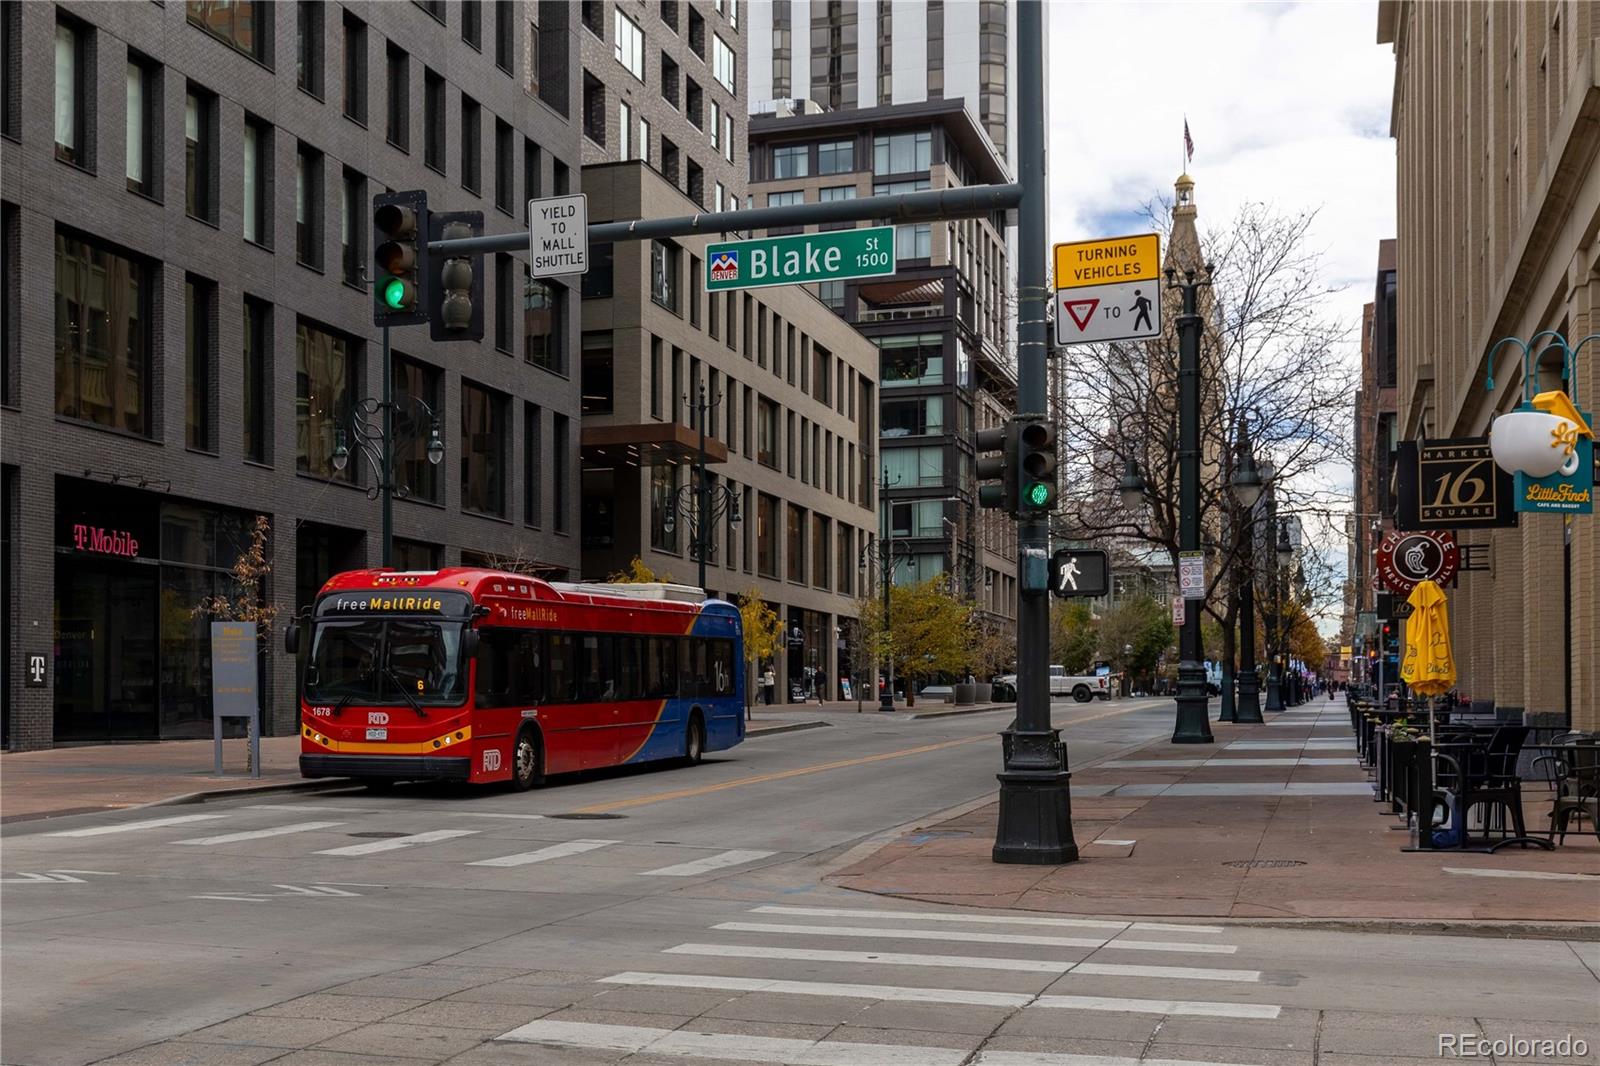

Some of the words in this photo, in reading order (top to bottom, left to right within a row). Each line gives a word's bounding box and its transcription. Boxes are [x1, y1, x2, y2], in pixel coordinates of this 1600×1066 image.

[541, 205, 575, 219] YIELD
[551, 222, 566, 234] TO
[543, 237, 575, 252] MALL
[866, 237, 879, 250] St
[535, 252, 584, 268] SHUTTLE
[856, 252, 888, 267] 1500
[1077, 244, 1137, 261] TURNING
[751, 242, 842, 279] Blake
[712, 270, 738, 281] DENVER
[1074, 262, 1142, 280] VEHICLES
[1103, 306, 1121, 319] TO
[1423, 449, 1491, 459] MARKET
[1434, 459, 1486, 507] 16
[1526, 483, 1561, 501] Little
[1558, 483, 1591, 502] Finch
[1423, 507, 1491, 518] SQUARE
[89, 527, 139, 557] Mobile
[1382, 529, 1455, 553] CHILE
[1383, 566, 1416, 591] MEXIC
[1435, 564, 1454, 585] RILL
[417, 680, 424, 690] 6
[312, 707, 331, 717] 1678
[368, 712, 389, 725] RTD
[483, 749, 502, 772] RTD
